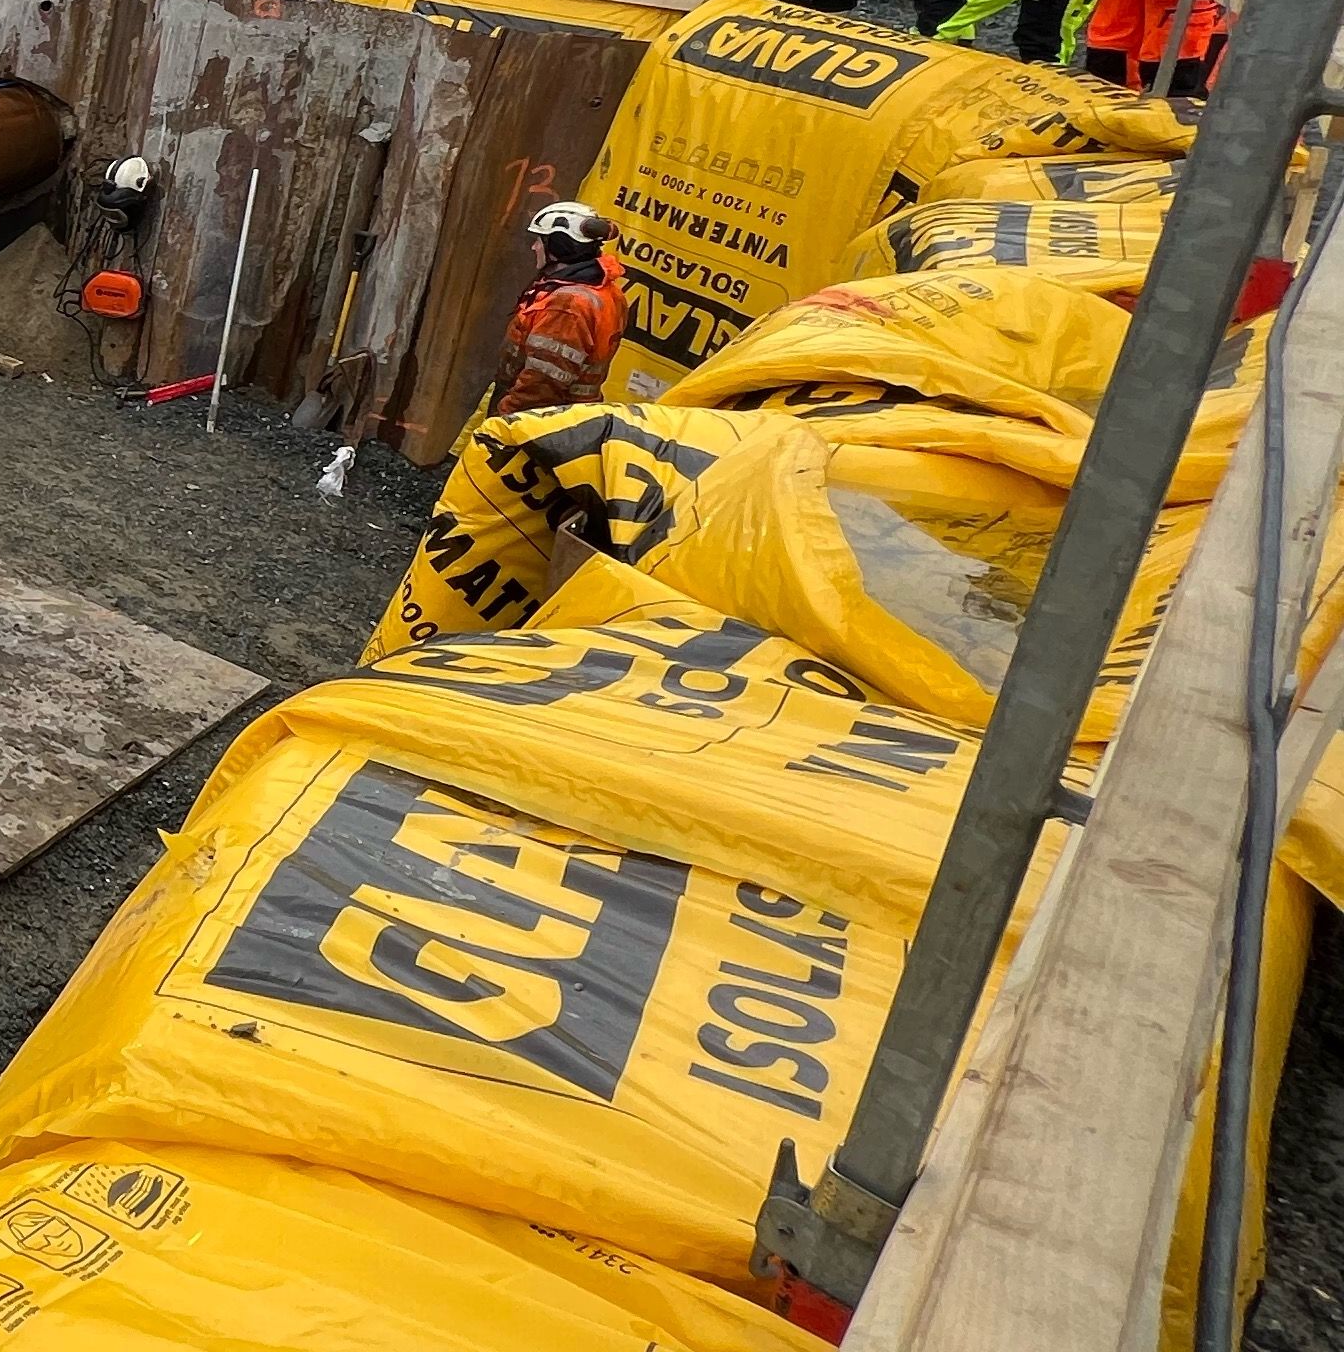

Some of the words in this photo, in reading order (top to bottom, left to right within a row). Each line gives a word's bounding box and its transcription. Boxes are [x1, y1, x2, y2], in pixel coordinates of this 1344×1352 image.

[706, 21, 899, 89] GLAVA
[661, 174, 696, 196] 3000
[697, 188, 708, 200] X
[712, 192, 753, 214] 1200
[613, 185, 790, 269] VINTERMATTE
[758, 205, 771, 220] X
[615, 233, 750, 303] ISOLASJON
[318, 787, 624, 1042] GLA
